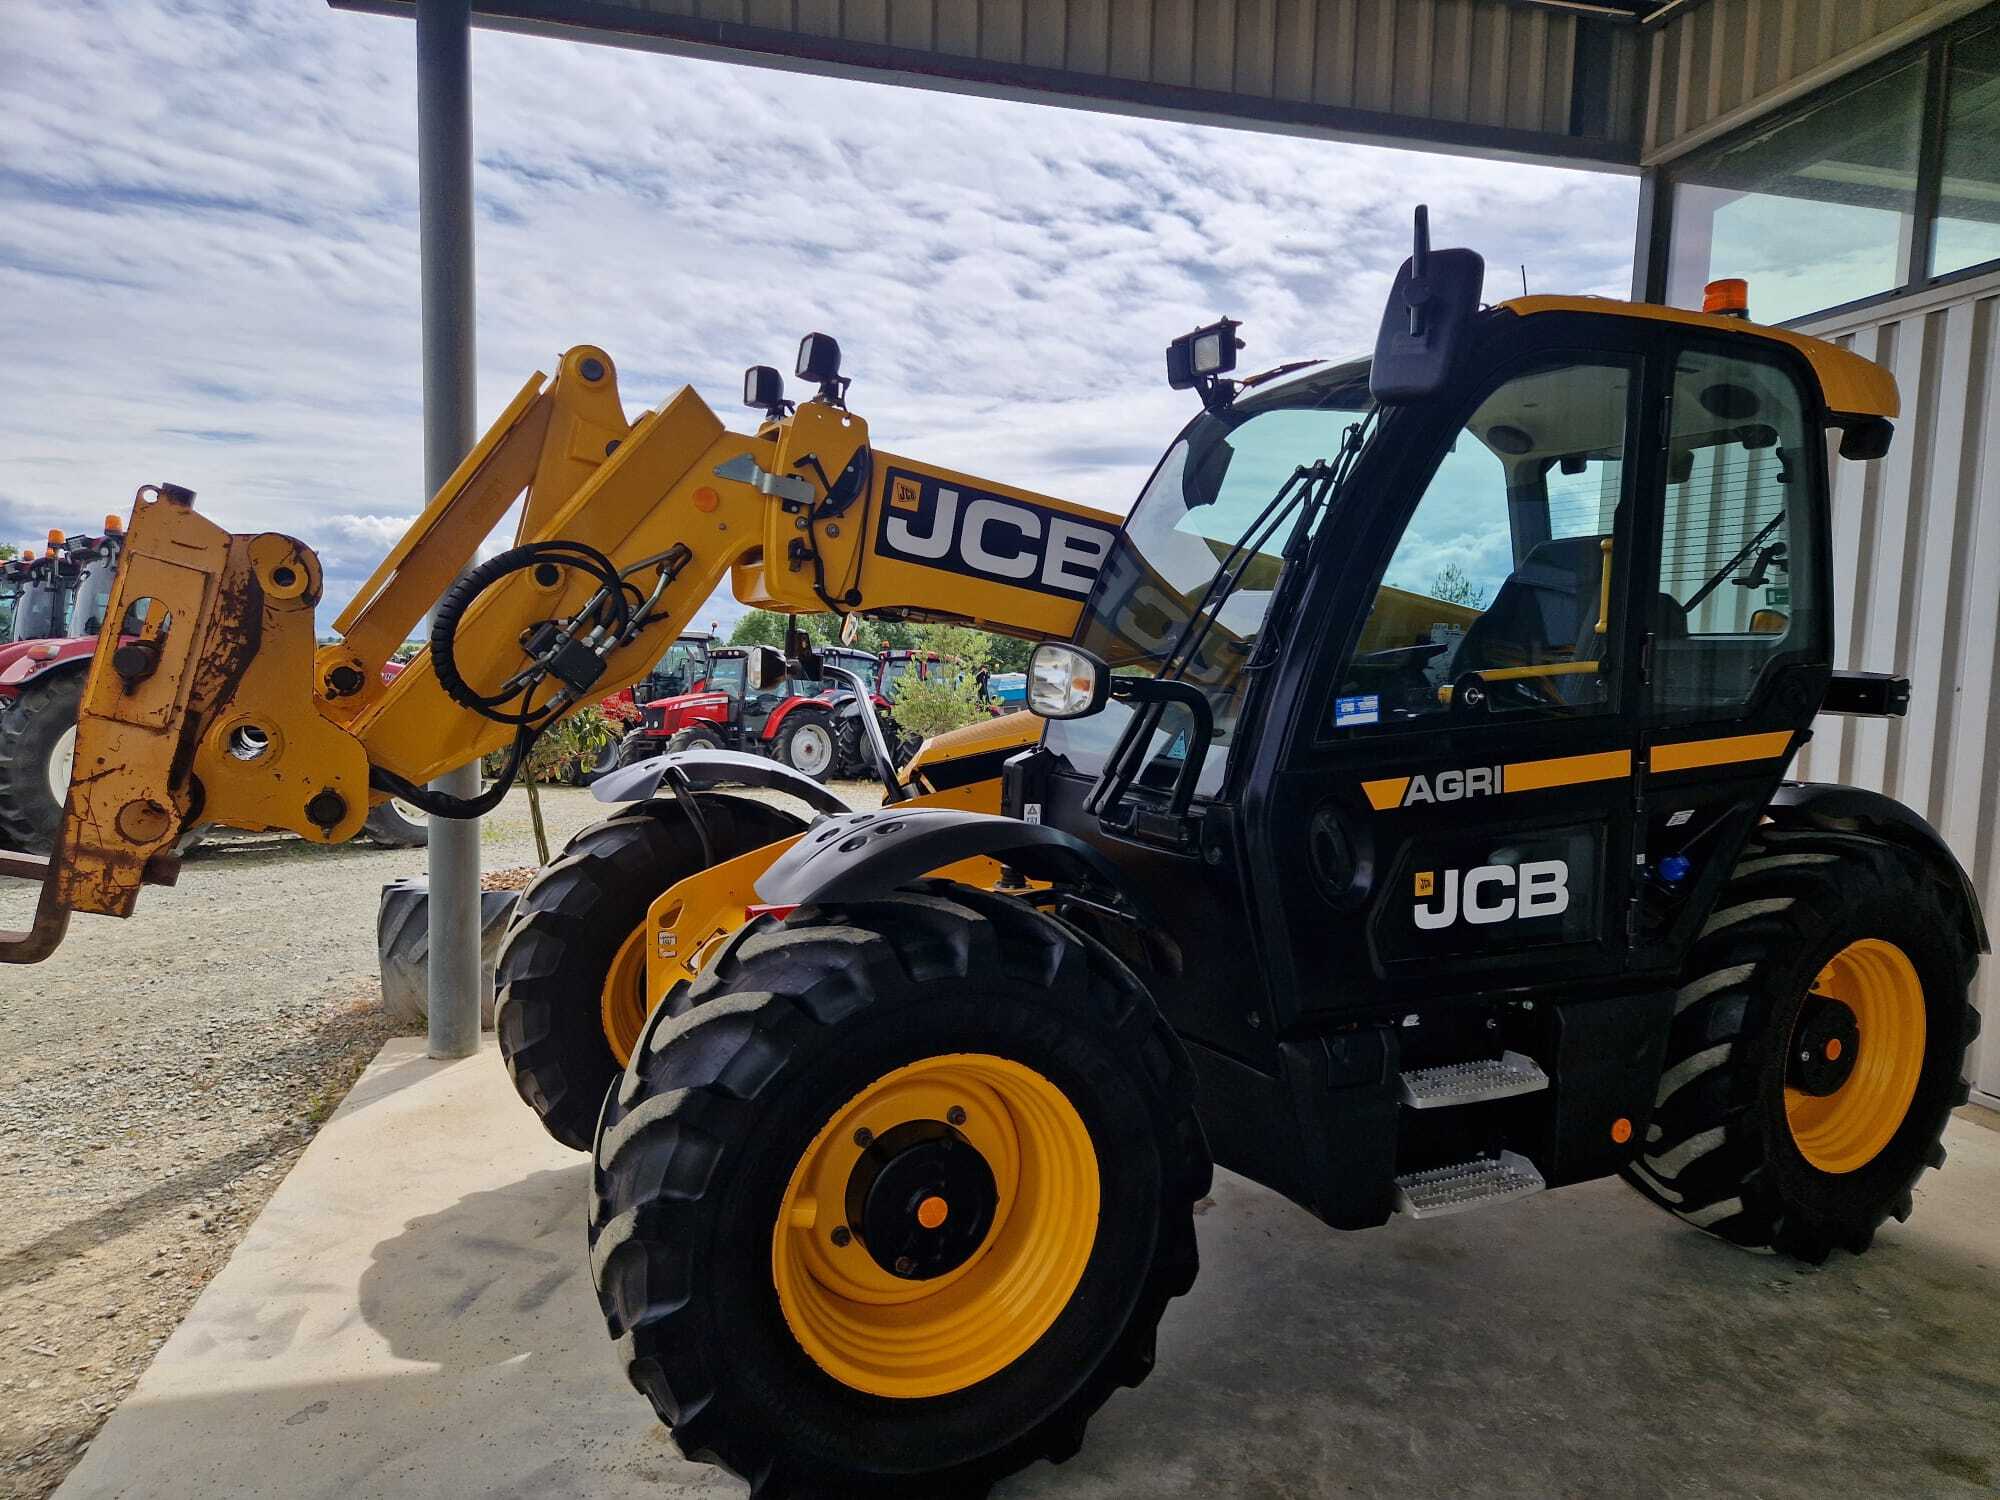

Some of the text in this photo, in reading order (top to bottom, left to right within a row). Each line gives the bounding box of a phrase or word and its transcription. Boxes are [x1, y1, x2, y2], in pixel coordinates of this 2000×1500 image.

[887, 488, 1115, 594] JCB
[1404, 765, 1501, 807] AGRI
[1414, 860, 1569, 930] JCB
